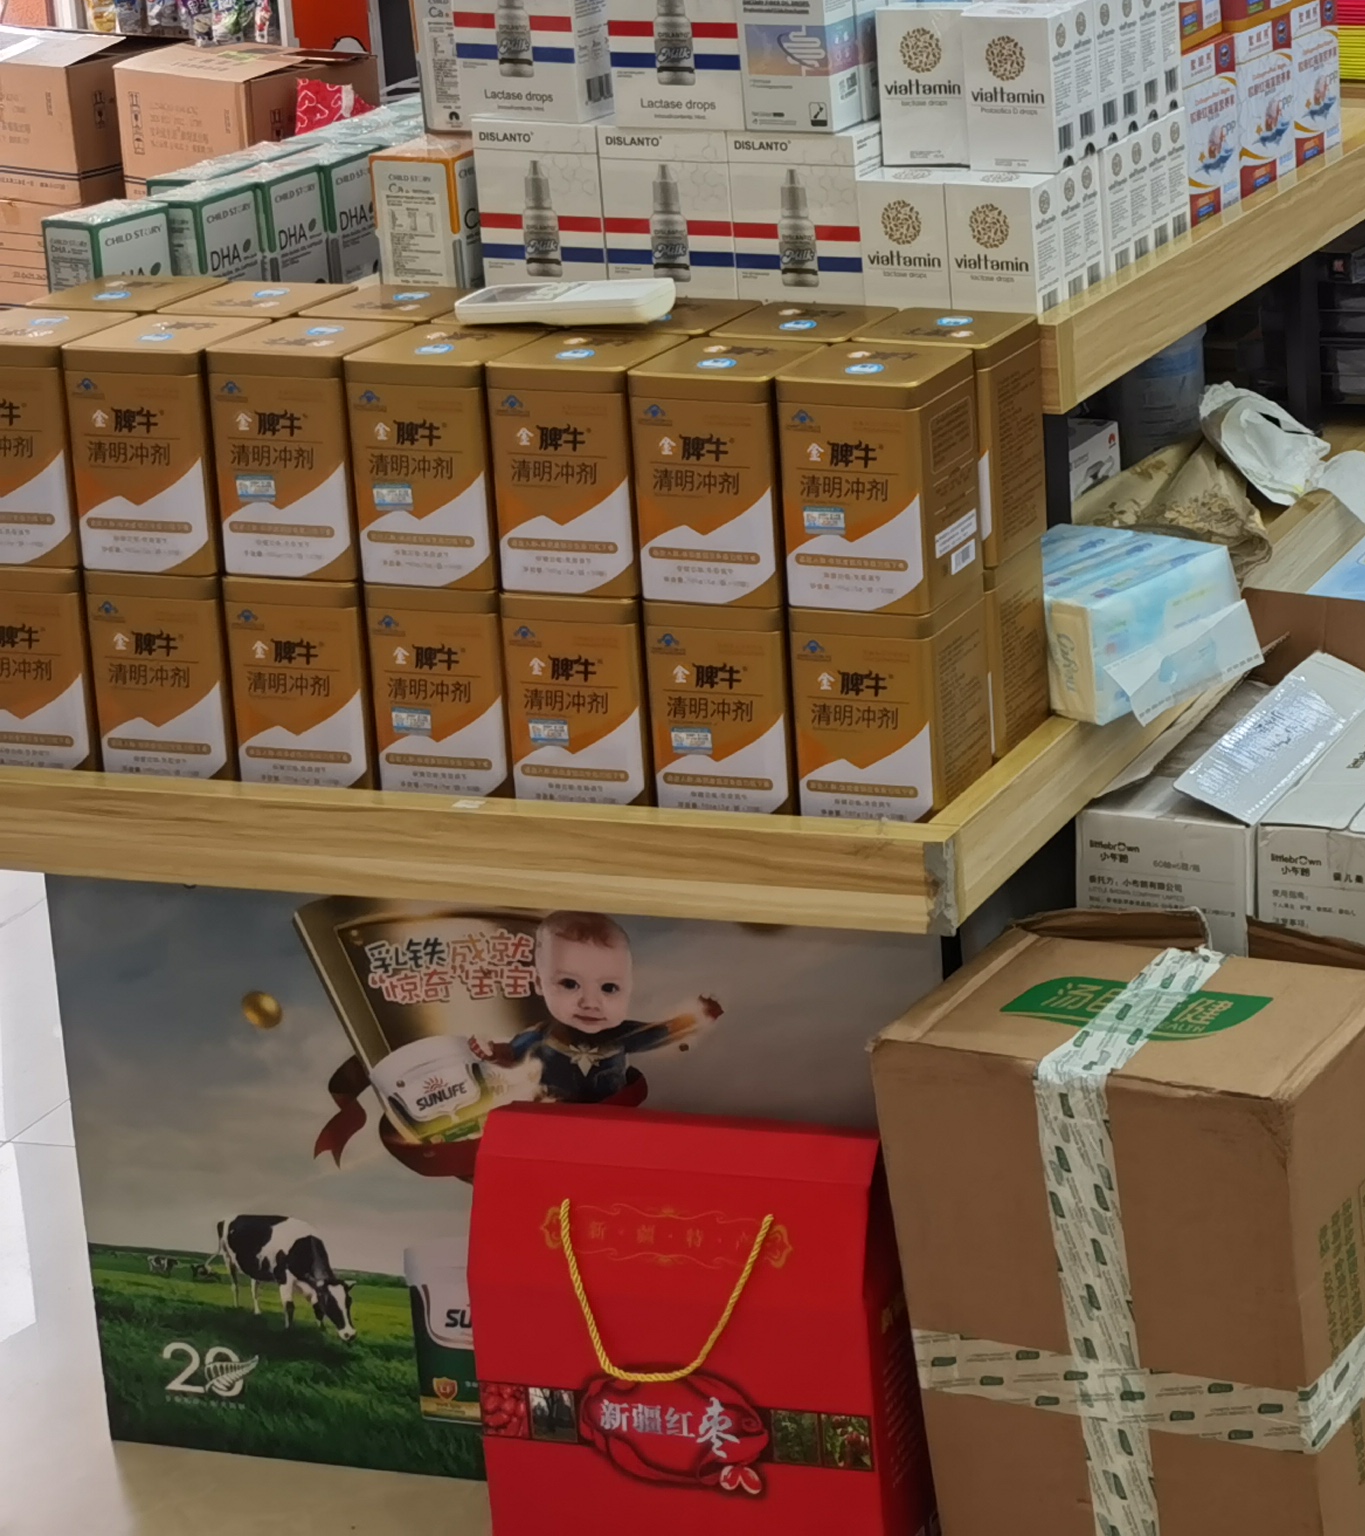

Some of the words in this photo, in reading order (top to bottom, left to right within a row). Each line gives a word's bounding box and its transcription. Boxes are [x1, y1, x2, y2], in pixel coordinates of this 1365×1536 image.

[484, 90, 521, 102] Lactase
[524, 91, 554, 105] drops
[640, 98, 679, 110] Lactase
[682, 98, 716, 112] drops
[478, 131, 531, 144] DISLANTO
[734, 140, 787, 152] DISLANTO
[104, 231, 132, 247] CHILD
[134, 224, 162, 239] STORY
[211, 250, 241, 272] DHA
[87, 441, 171, 466] 清明冲剂
[230, 443, 314, 470] 清明冲剂
[369, 453, 453, 480] 清明冲剂
[511, 459, 597, 485] 清明冲剂
[653, 468, 740, 496] 清明冲剂
[800, 474, 888, 502] 清明冲剂
[108, 665, 190, 688] 清明冲剂
[387, 678, 471, 703] 清明冲剂
[667, 697, 753, 723] 清明冲剂
[811, 703, 899, 731] 清明冲剂
[1100, 852, 1129, 864] 小布朗
[1281, 866, 1310, 877] 小布朗
[367, 933, 533, 973] 乳铁成就
[415, 1081, 470, 1111] SUNLIFE
[599, 1397, 739, 1458] 新疆红枣
